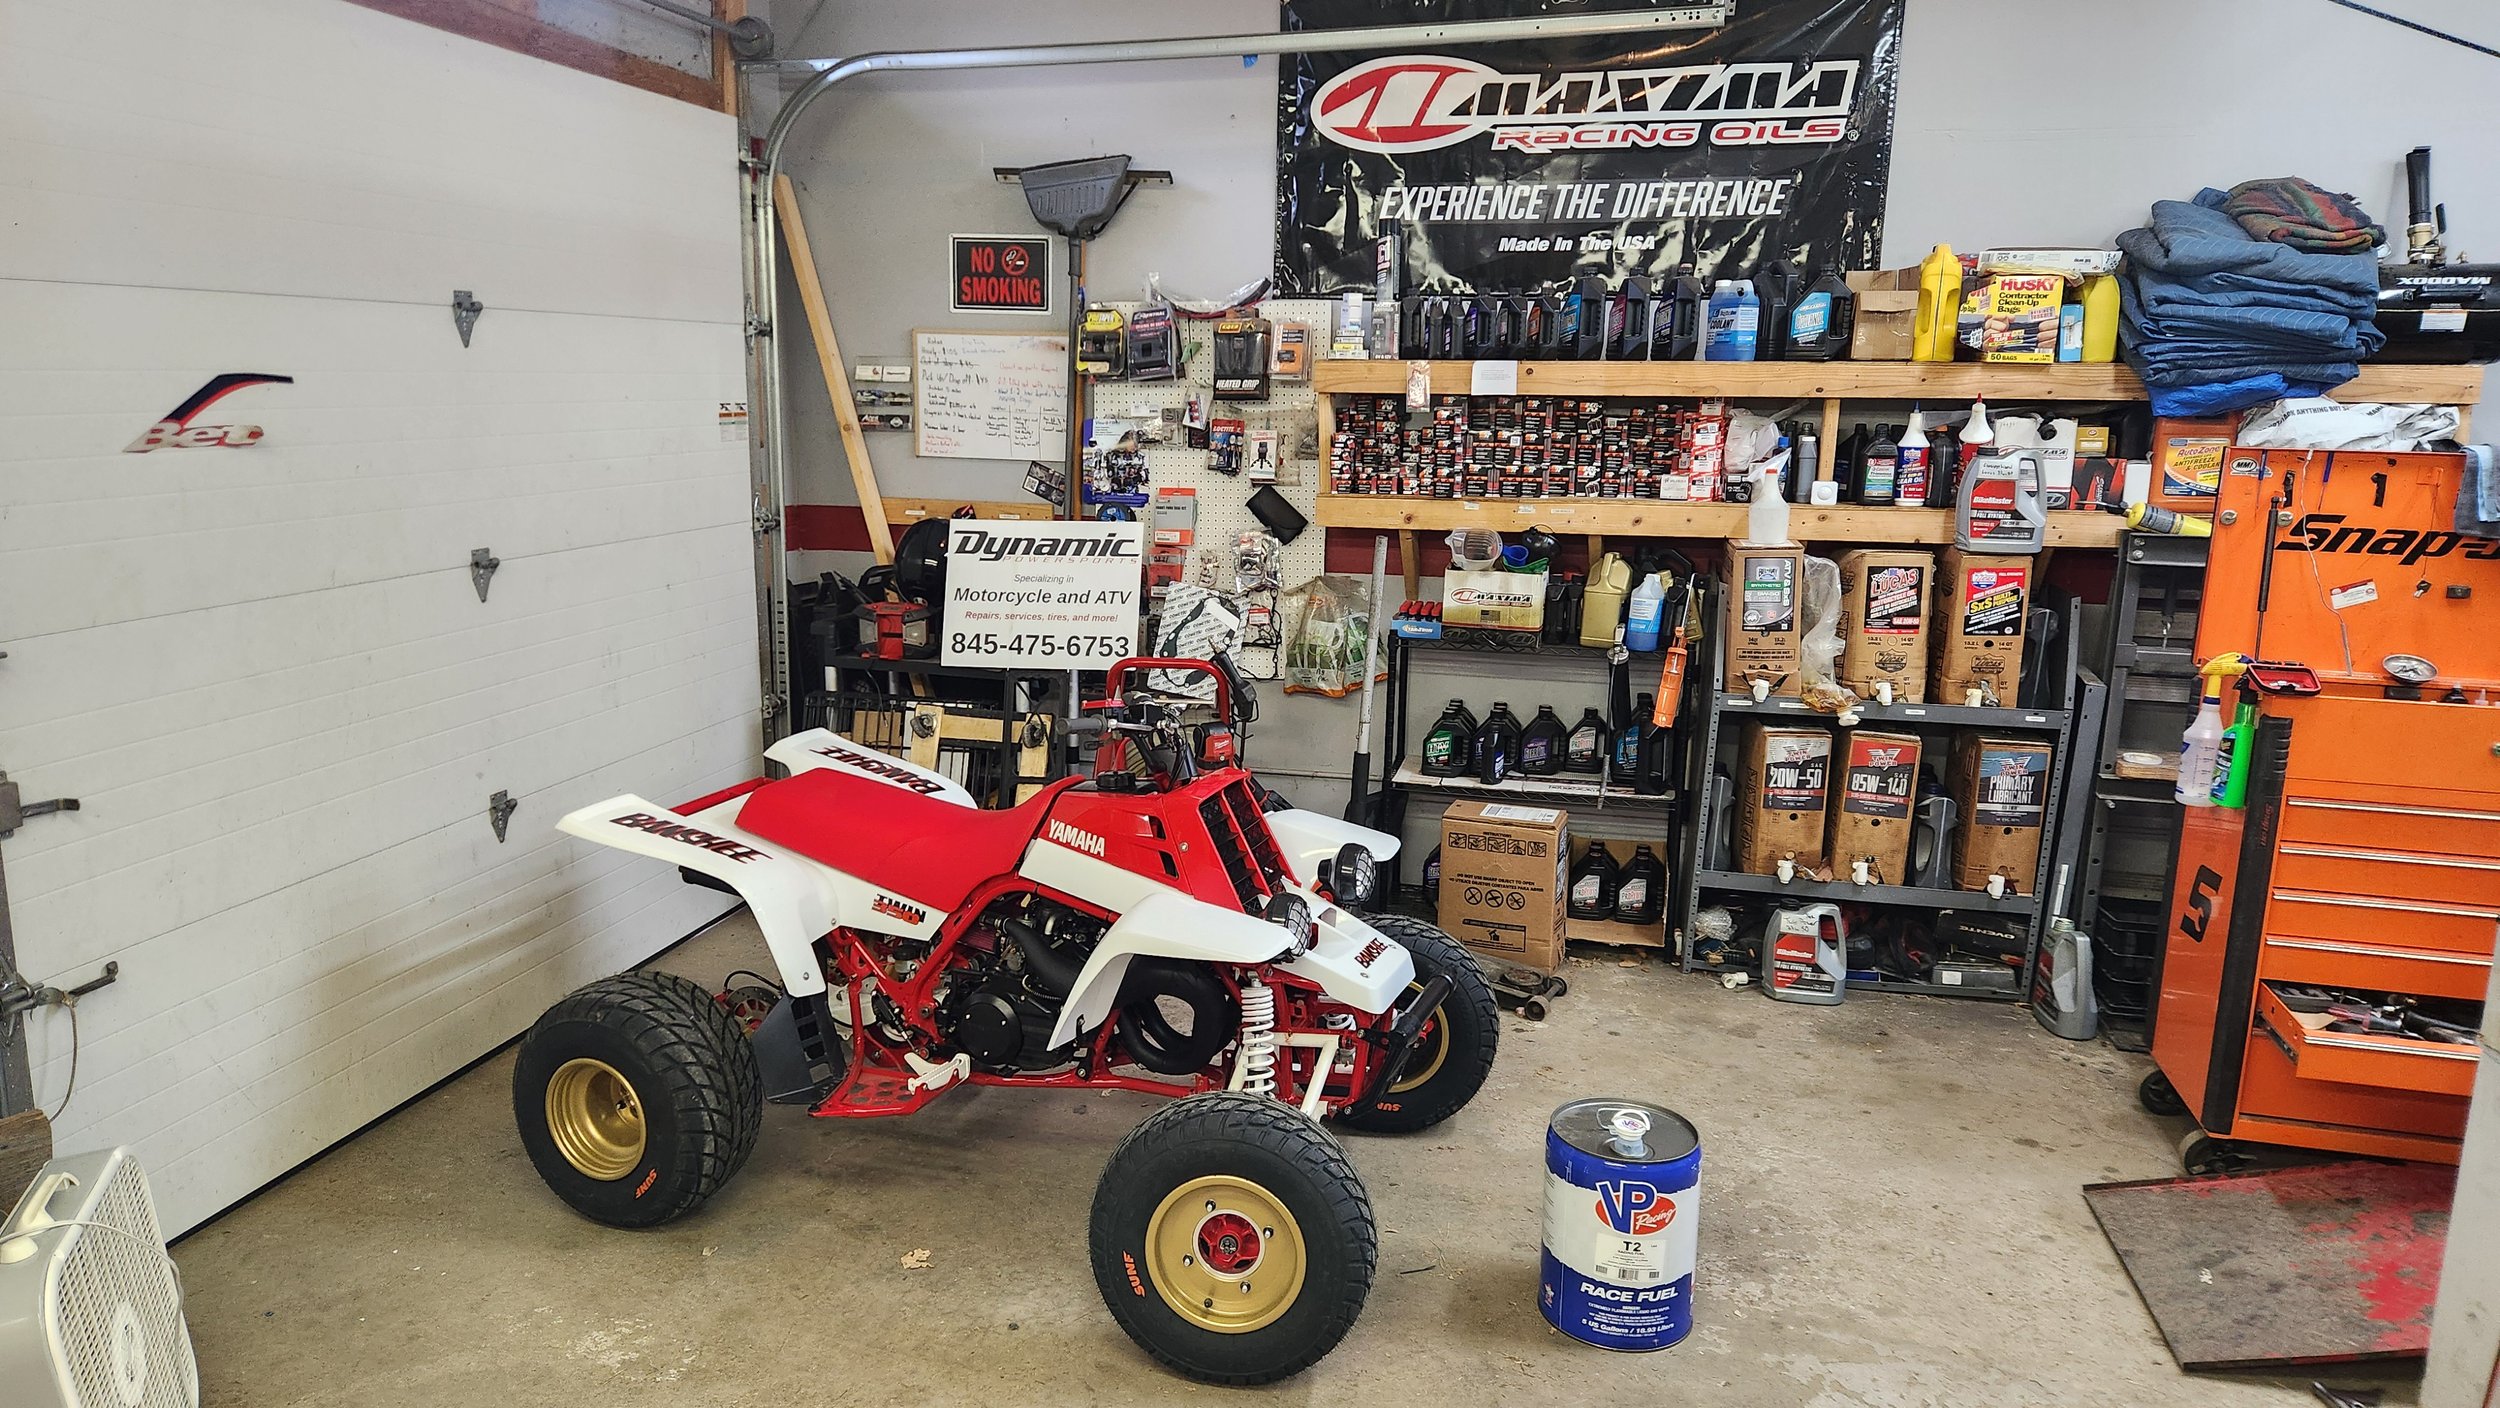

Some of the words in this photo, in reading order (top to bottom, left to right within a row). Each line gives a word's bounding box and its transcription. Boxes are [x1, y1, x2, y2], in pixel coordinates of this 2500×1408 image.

[1446, 62, 1856, 120] MAXIMA
[1711, 120, 1846, 144] OILS
[1379, 184, 1548, 221] EXPERIENCE
[1553, 183, 1612, 220] THE
[1610, 178, 1791, 219] DIFFERENCE
[1498, 236, 1549, 252] Made
[1553, 236, 1573, 251] In
[1578, 236, 1612, 251] The
[1618, 235, 1655, 251] USA
[971, 246, 994, 273] NO
[961, 276, 1041, 304] SMOKING
[2000, 279, 2058, 291] HUSKY
[1997, 306, 2021, 314] Bags
[1998, 299, 2039, 308] Clean-Up
[1709, 319, 1734, 329] COOLANT
[1216, 379, 1241, 388] HEATED
[1242, 379, 1259, 388] GRIP
[2296, 406, 2329, 417] ANYTHING
[1213, 425, 1234, 433] LOCTITE
[2177, 446, 2220, 457] AutoZone
[2173, 457, 2216, 467] ANTIFREEZE
[953, 530, 1140, 562] Dynamic
[1002, 556, 1138, 565] POWERSPORTS
[1014, 574, 1064, 584] Specializing
[1066, 575, 1074, 583] in
[1871, 569, 1919, 597] LUCAS
[953, 588, 1052, 606] Motorcycle
[1057, 590, 1091, 604] and
[1094, 591, 1132, 604] ATV
[1970, 598, 1993, 614] SxS
[965, 611, 1002, 621] Repairs,
[1004, 612, 1045, 622] services,
[1047, 613, 1070, 622] tires,
[1072, 614, 1090, 622] and
[1091, 614, 1119, 622] more!
[951, 632, 1130, 658] 845-475-6753
[809, 745, 947, 795] BANSHEE
[1769, 767, 1823, 789] 20W-50
[1851, 773, 1908, 796] 85W-140
[1989, 775, 2035, 791] PRIMARY
[1988, 789, 2034, 804] LUBRICANT
[609, 812, 773, 865] BANSHEE
[1048, 818, 1105, 857] YAMAHA
[1482, 831, 1512, 839] INSTRUCTIONS
[1959, 924, 2015, 940] OVENTE
[1354, 937, 1388, 969] BANSHEE
[635, 1168, 657, 1199] SUNF
[1595, 1180, 1658, 1236] VP
[1635, 1206, 1677, 1230] Racing
[1622, 1240, 1642, 1252] T2
[1122, 1250, 1146, 1297] SUNF
[1580, 1281, 1635, 1302] RACE
[1637, 1286, 1679, 1303] FUEL
[1588, 1319, 1600, 1329] US
[1600, 1323, 1629, 1334] Gallons
